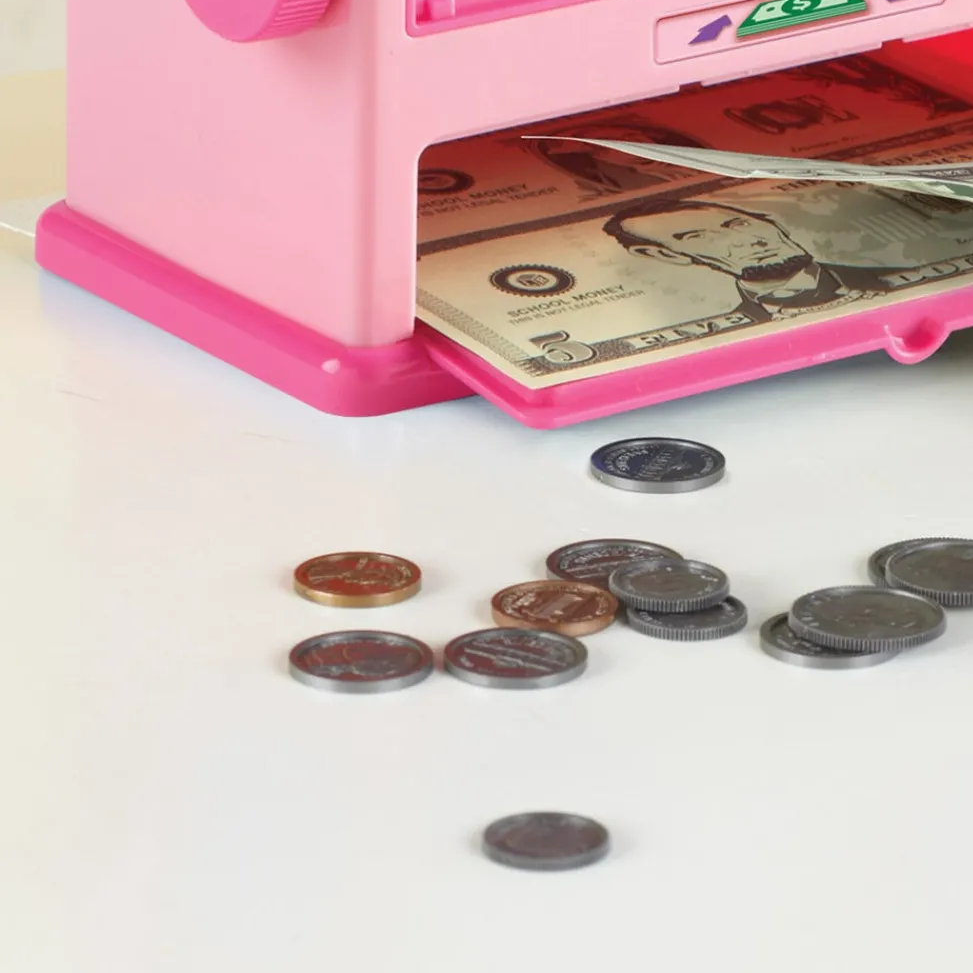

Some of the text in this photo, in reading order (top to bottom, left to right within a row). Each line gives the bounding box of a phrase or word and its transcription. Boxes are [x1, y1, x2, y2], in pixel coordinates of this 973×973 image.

[506, 283, 625, 318] SCHOOL MONEY
[545, 307, 568, 317] NOT
[567, 299, 603, 312] LEGAL
[603, 288, 646, 303] TENDER
[528, 329, 598, 364] 5
[629, 312, 753, 348] FIVE
